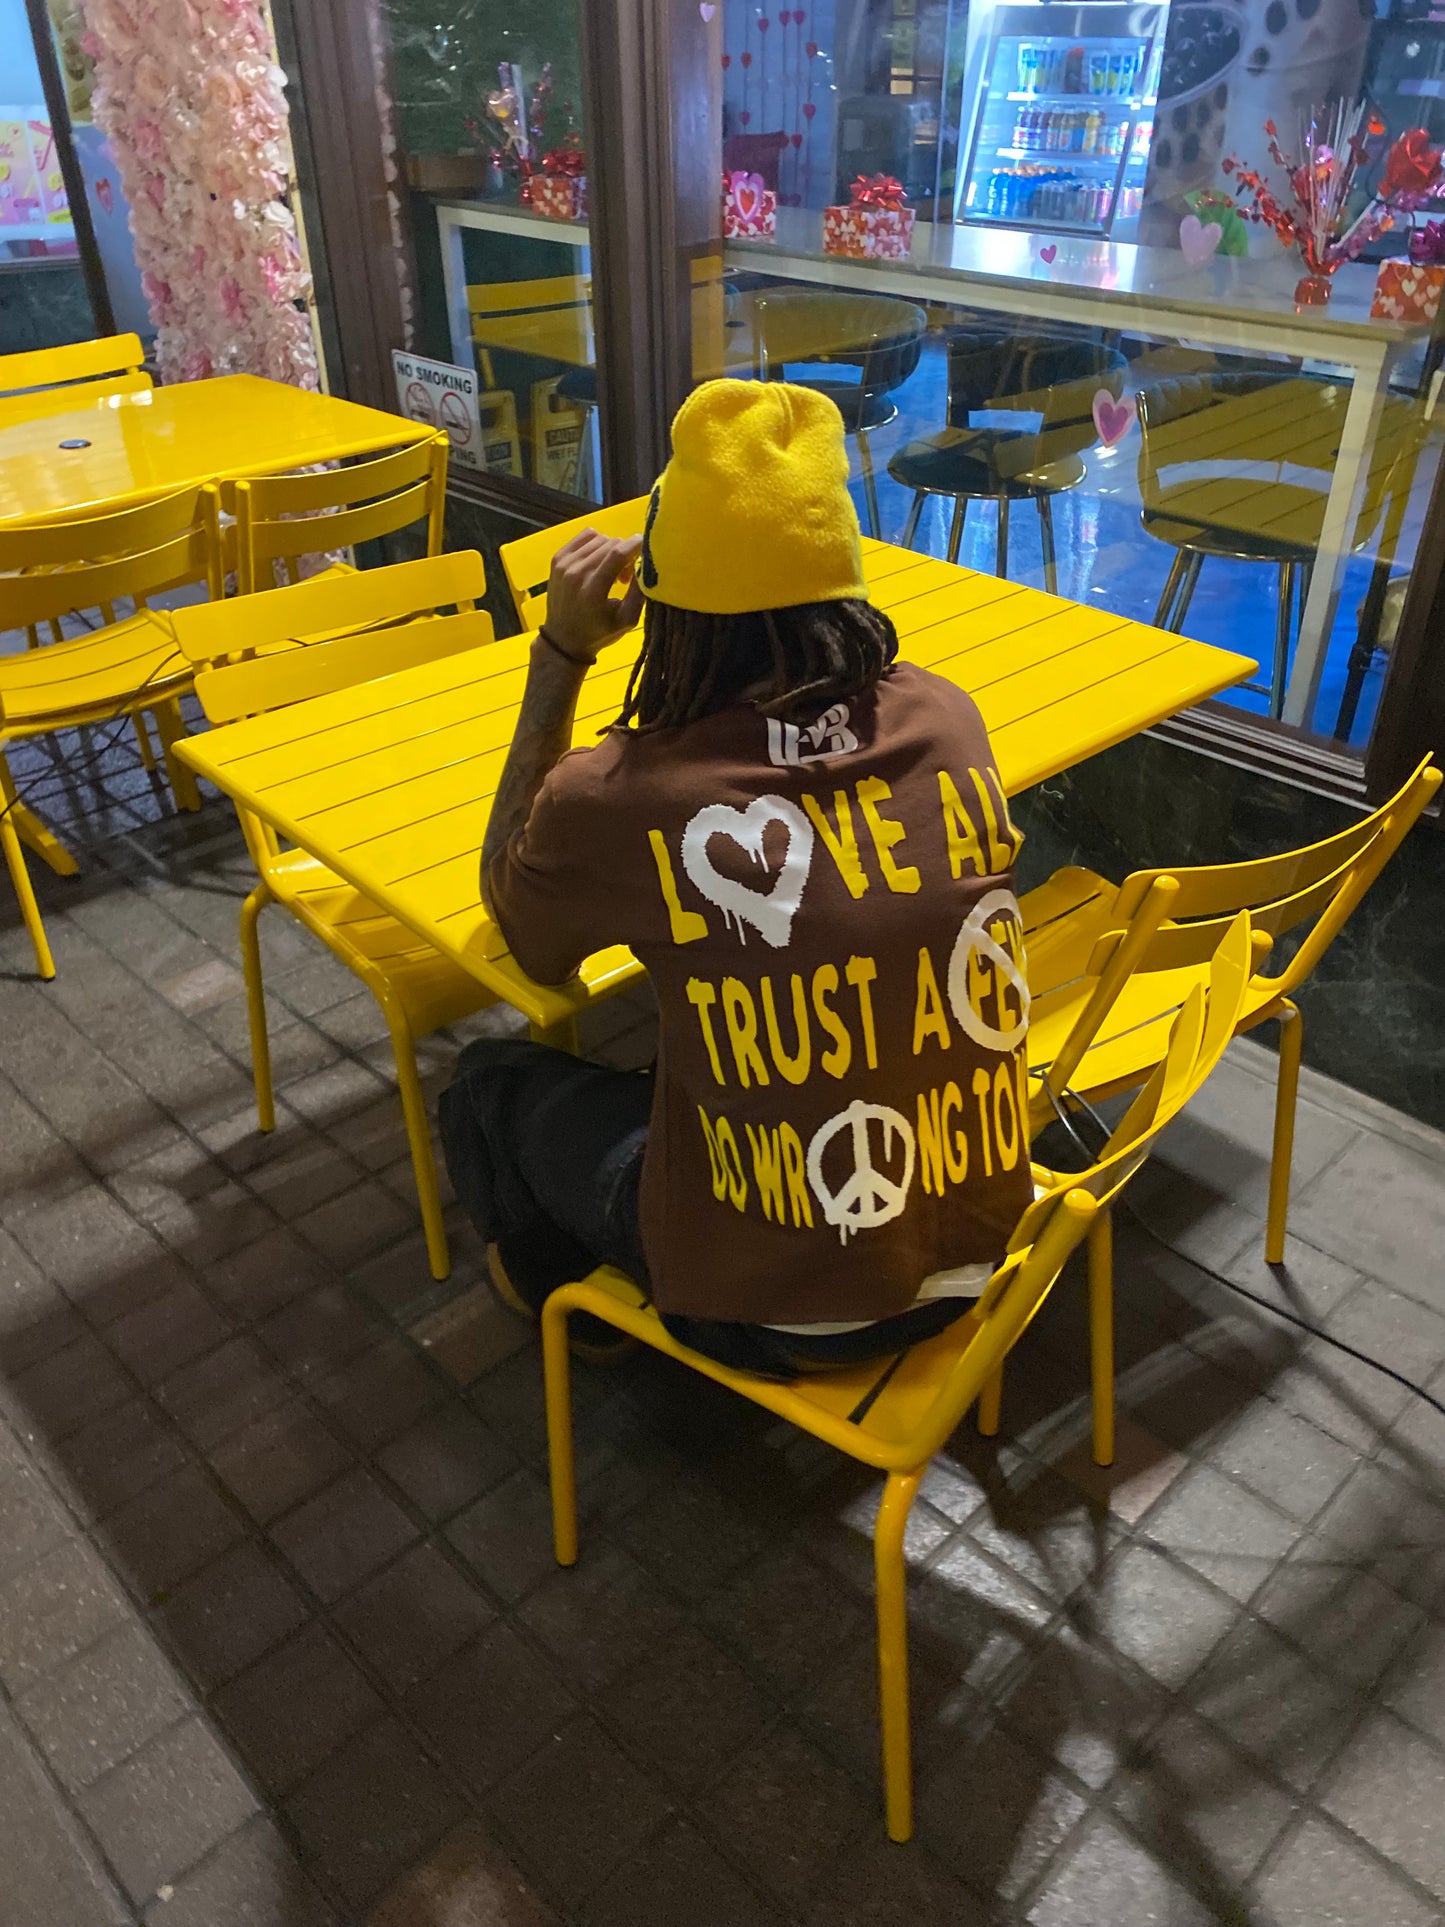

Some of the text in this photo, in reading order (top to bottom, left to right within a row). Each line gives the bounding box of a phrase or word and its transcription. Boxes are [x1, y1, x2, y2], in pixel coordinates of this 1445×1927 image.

[396, 361, 473, 394] NO SMOKING
[686, 954, 877, 1090] TRUST
[913, 946, 951, 1055] A
[697, 1104, 748, 1213] DO
